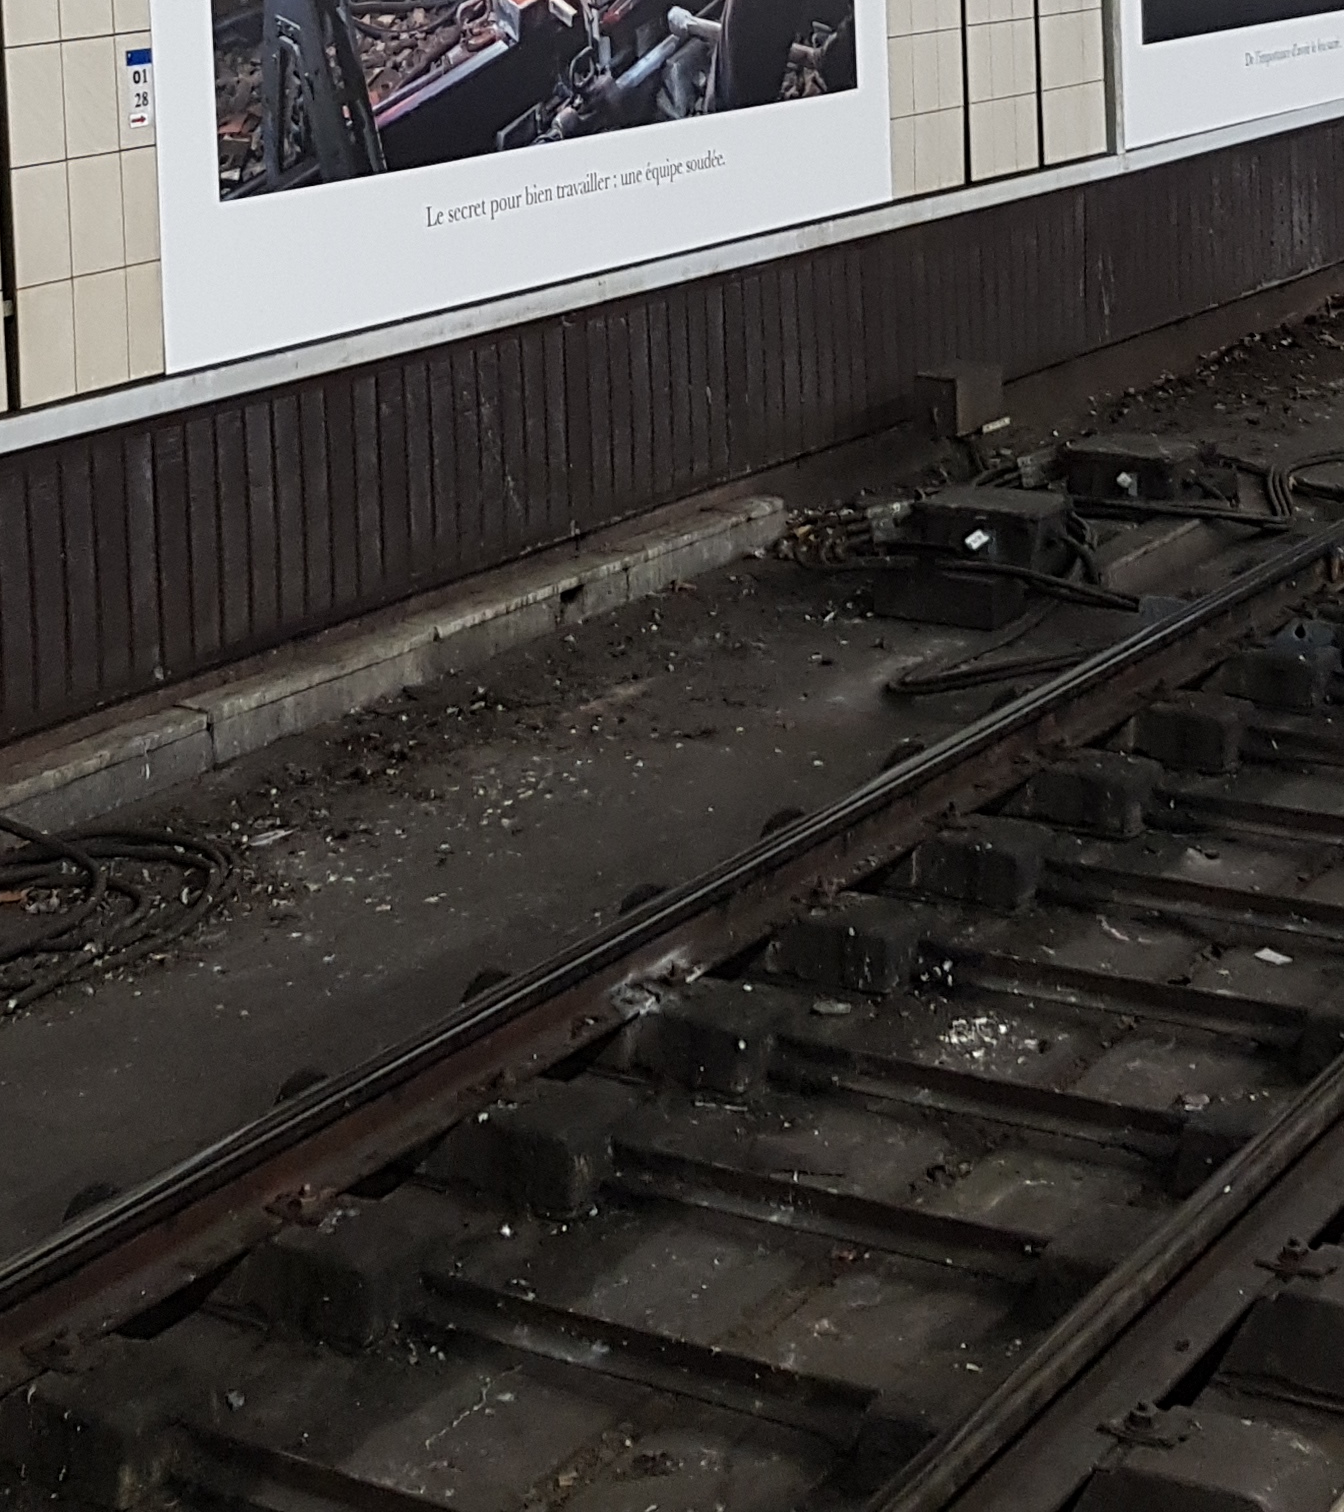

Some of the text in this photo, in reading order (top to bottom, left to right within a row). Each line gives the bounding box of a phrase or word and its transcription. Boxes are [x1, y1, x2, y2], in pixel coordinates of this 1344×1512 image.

[132, 69, 148, 84] 01
[134, 91, 149, 108] 28
[426, 206, 444, 228] Le
[447, 200, 487, 223] secret
[490, 194, 522, 220] pour
[525, 184, 553, 206] bien
[557, 172, 610, 200] travailler
[620, 169, 643, 187] une
[645, 158, 683, 186] équipe
[686, 150, 726, 173] soudée.
